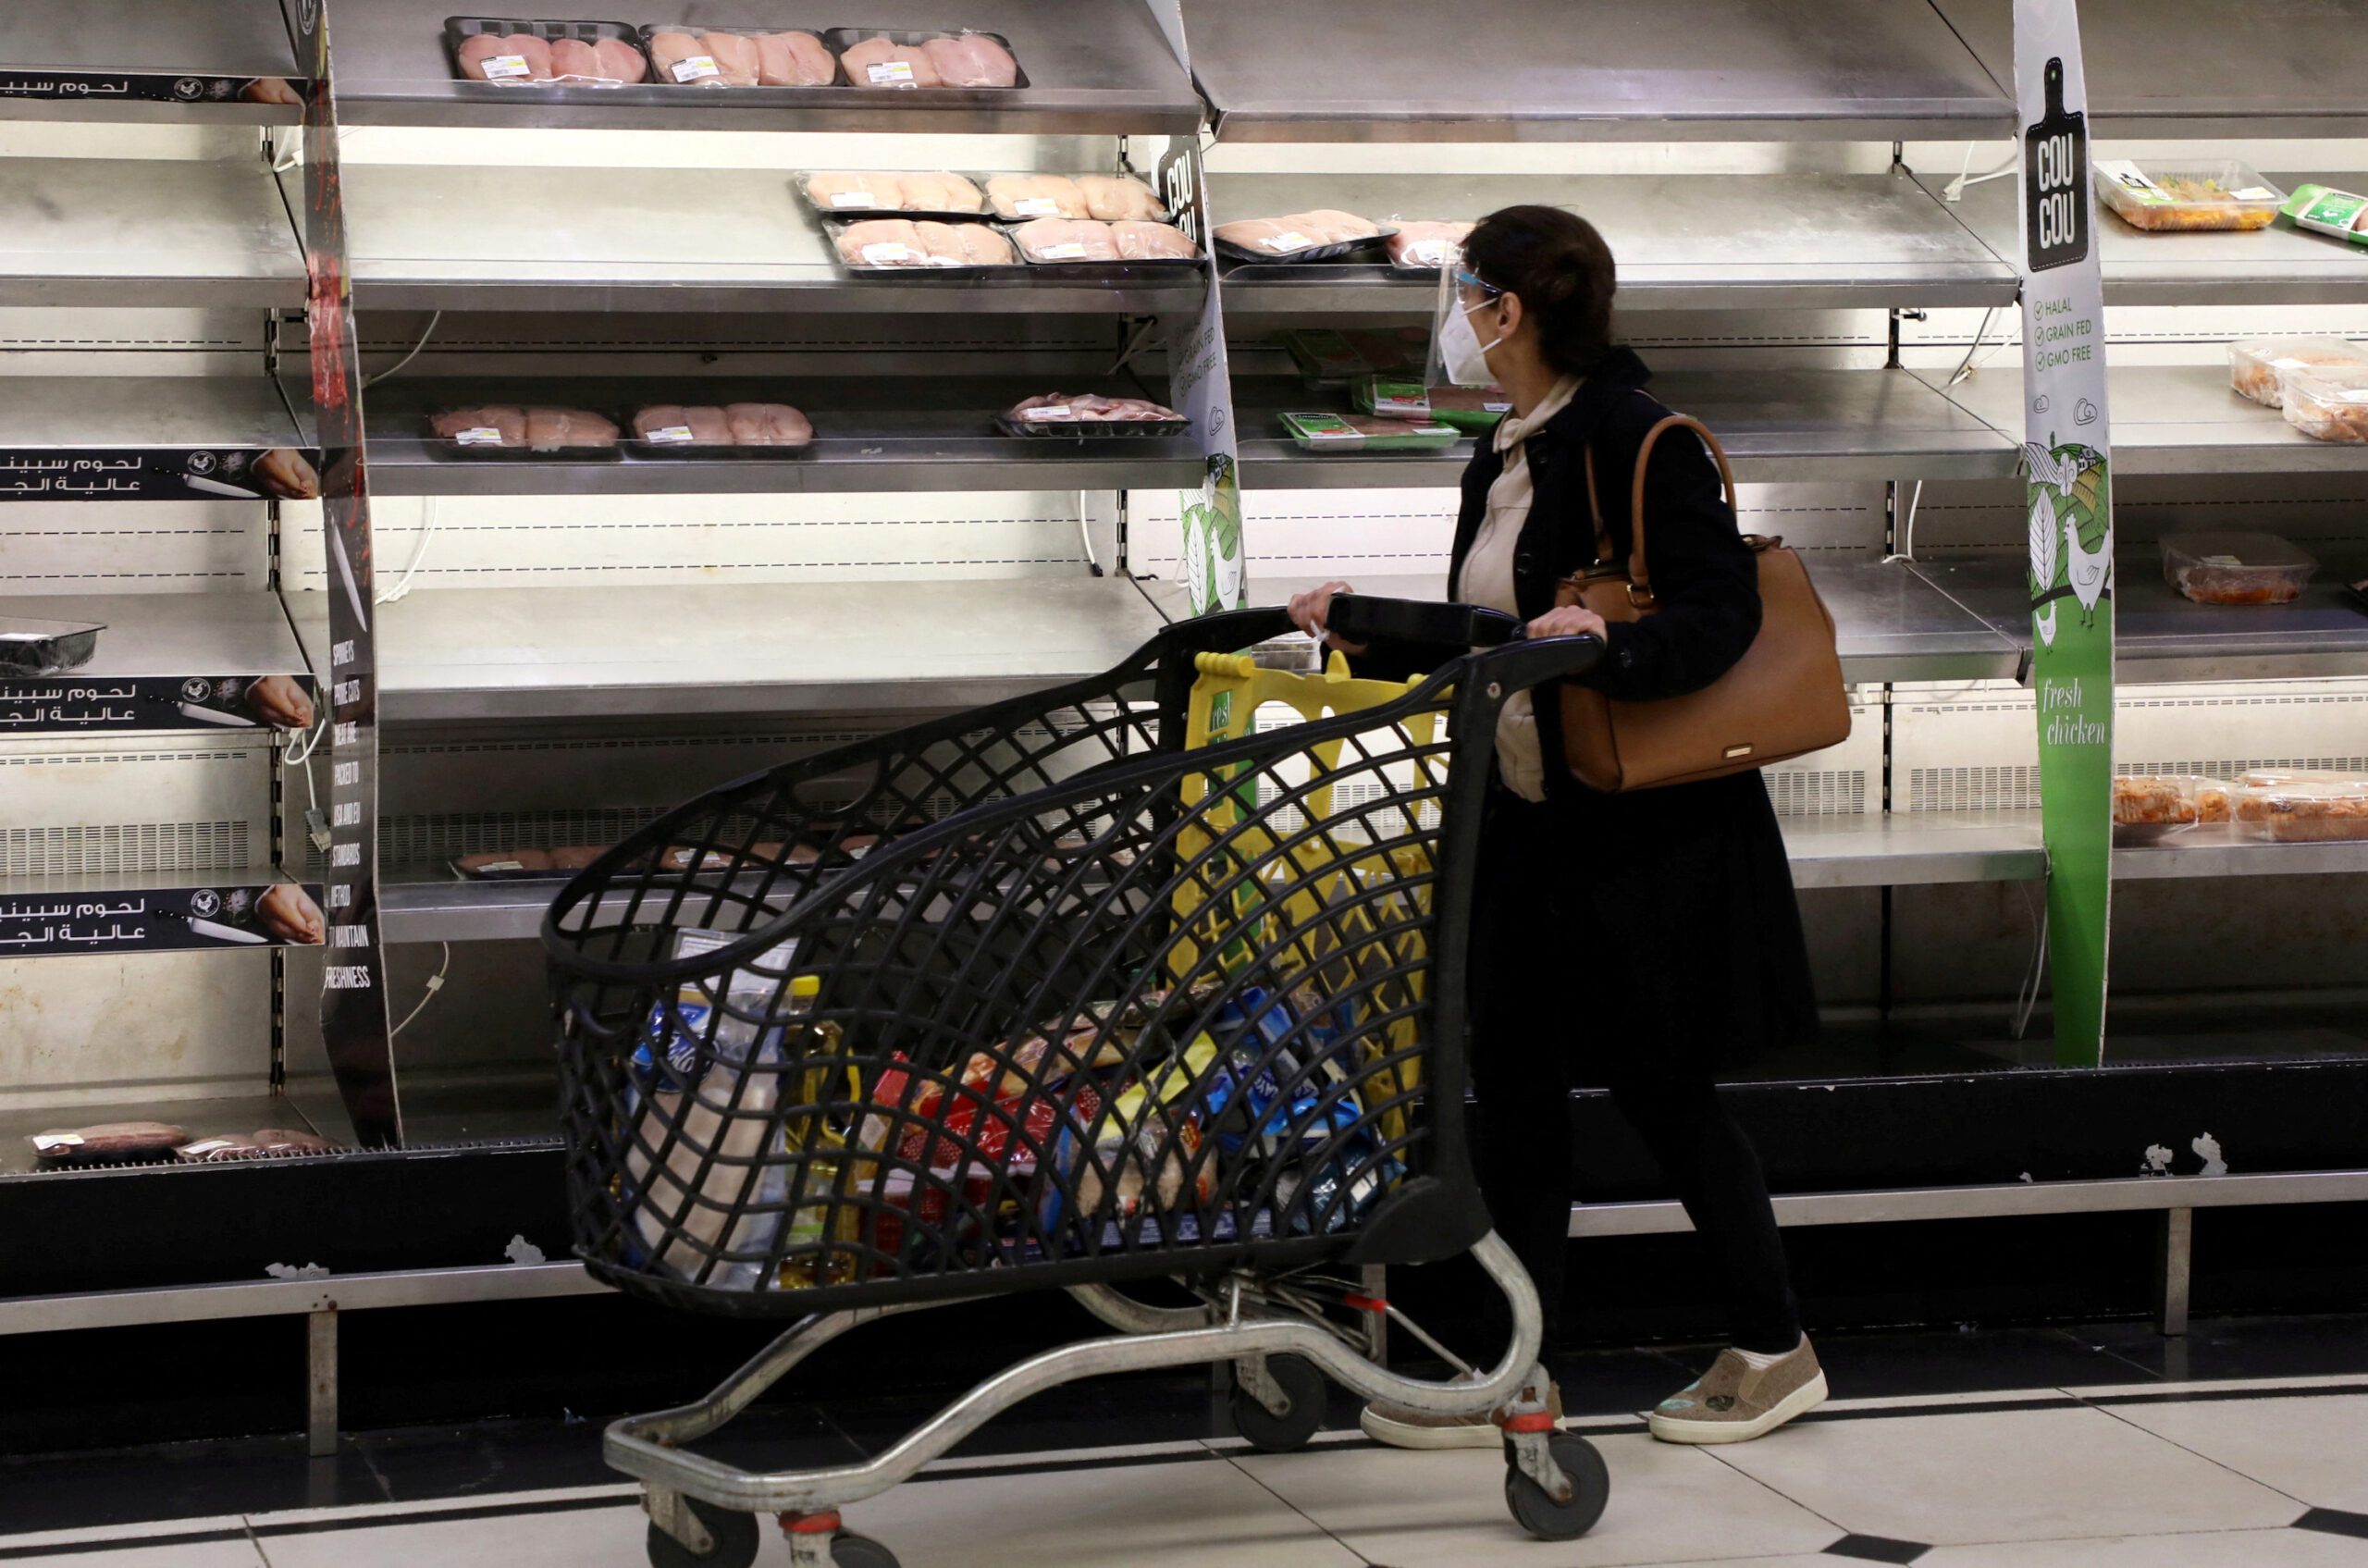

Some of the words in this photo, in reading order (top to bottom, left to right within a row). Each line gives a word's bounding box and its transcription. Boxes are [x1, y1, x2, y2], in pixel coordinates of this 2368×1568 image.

[59, 80, 128, 94] لحوم
[2038, 132, 2074, 192] COU
[1166, 149, 1193, 218] COU
[2039, 191, 2075, 250] COU
[2045, 297, 2072, 315] HALAL
[1204, 327, 1215, 346] FED
[2046, 323, 2074, 342] GRAIN
[2076, 319, 2092, 336] FED
[1203, 352, 1217, 375] FREE
[2047, 349, 2070, 367] GMO
[2072, 344, 2091, 363] FREE
[0, 456, 68, 474] سبين
[73, 456, 142, 472] لحوم
[0, 477, 50, 495] الج
[55, 475, 141, 495] عالية
[0, 686, 63, 704] سبين
[68, 684, 137, 701] لحوم
[2042, 677, 2082, 714] fresh
[0, 708, 44, 726] الج
[49, 706, 135, 725] عالية
[2047, 714, 2104, 746] chicken
[333, 843, 360, 868] STANDARDS
[0, 902, 71, 922] سبين
[76, 897, 144, 919] لحوم
[0, 926, 54, 947] الج
[58, 923, 145, 945] عالية
[335, 925, 369, 947] MAINTAIN
[325, 965, 370, 989] FRESHNESS
